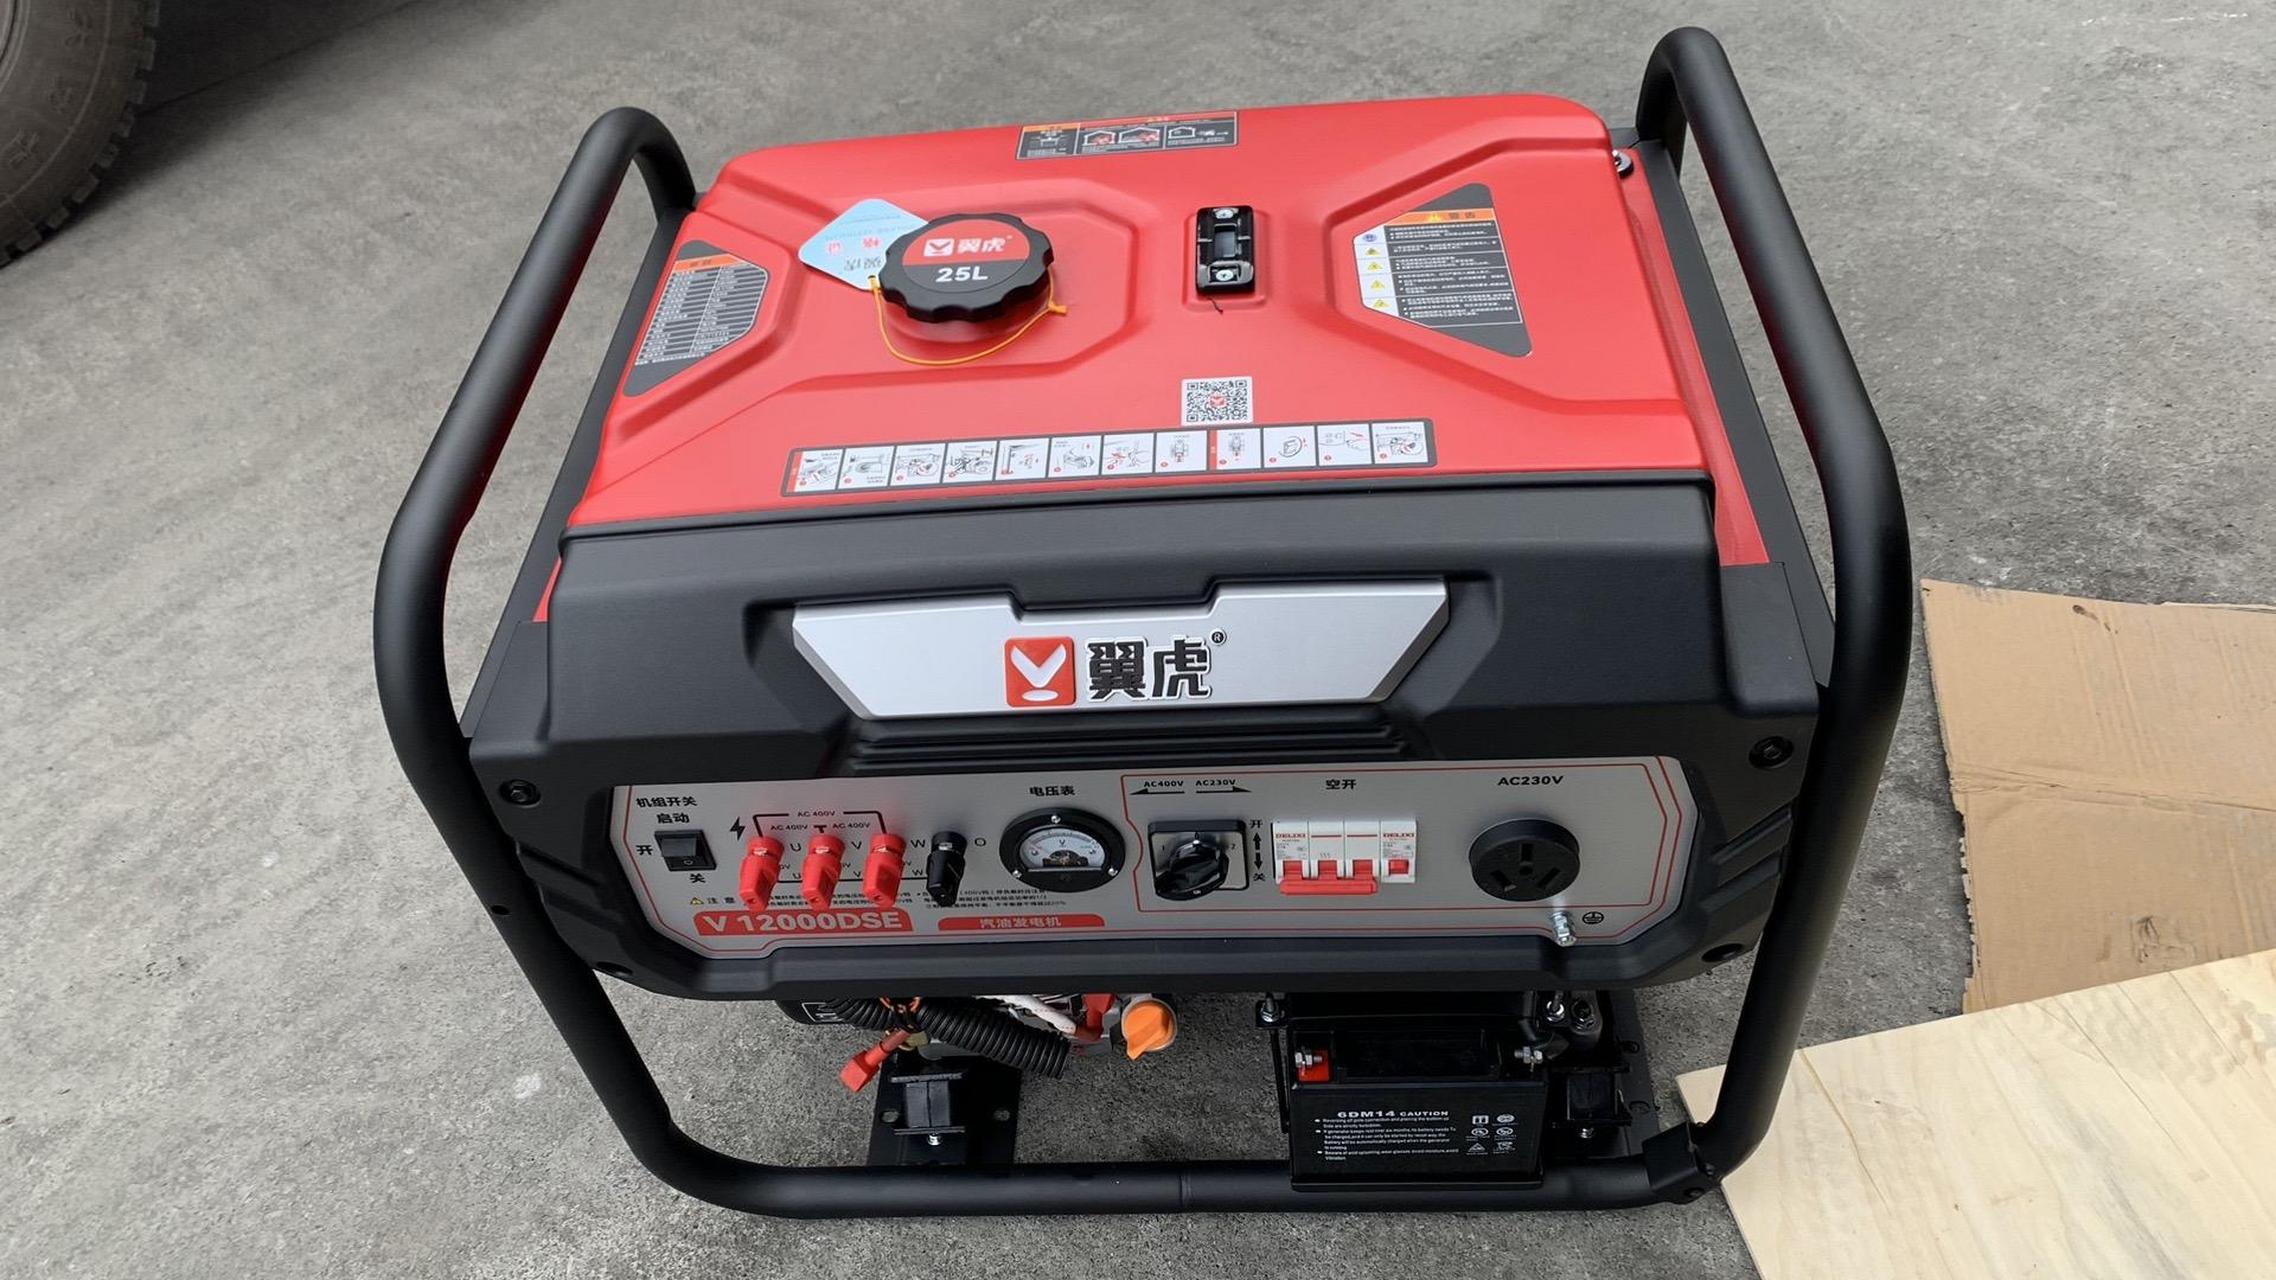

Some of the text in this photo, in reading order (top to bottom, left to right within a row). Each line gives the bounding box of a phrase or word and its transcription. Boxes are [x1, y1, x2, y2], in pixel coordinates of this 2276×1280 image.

[935, 266, 989, 283] 25L
[1088, 638, 1210, 700] 翼虎
[1144, 780, 1185, 788] AC400V
[1195, 778, 1236, 787] AC230V
[1325, 779, 1357, 790] 空开
[1497, 775, 1564, 786] AC230V
[1029, 785, 1075, 797] 电压表
[636, 797, 697, 808] 机组开关
[657, 813, 690, 824] 启动
[1249, 819, 1263, 829] 开
[790, 843, 801, 852] U
[851, 841, 863, 851] V
[911, 839, 927, 849] W
[636, 845, 653, 855] 开
[690, 873, 708, 884] 关
[1253, 872, 1266, 882] 关
[702, 911, 902, 932] V 12000DSE
